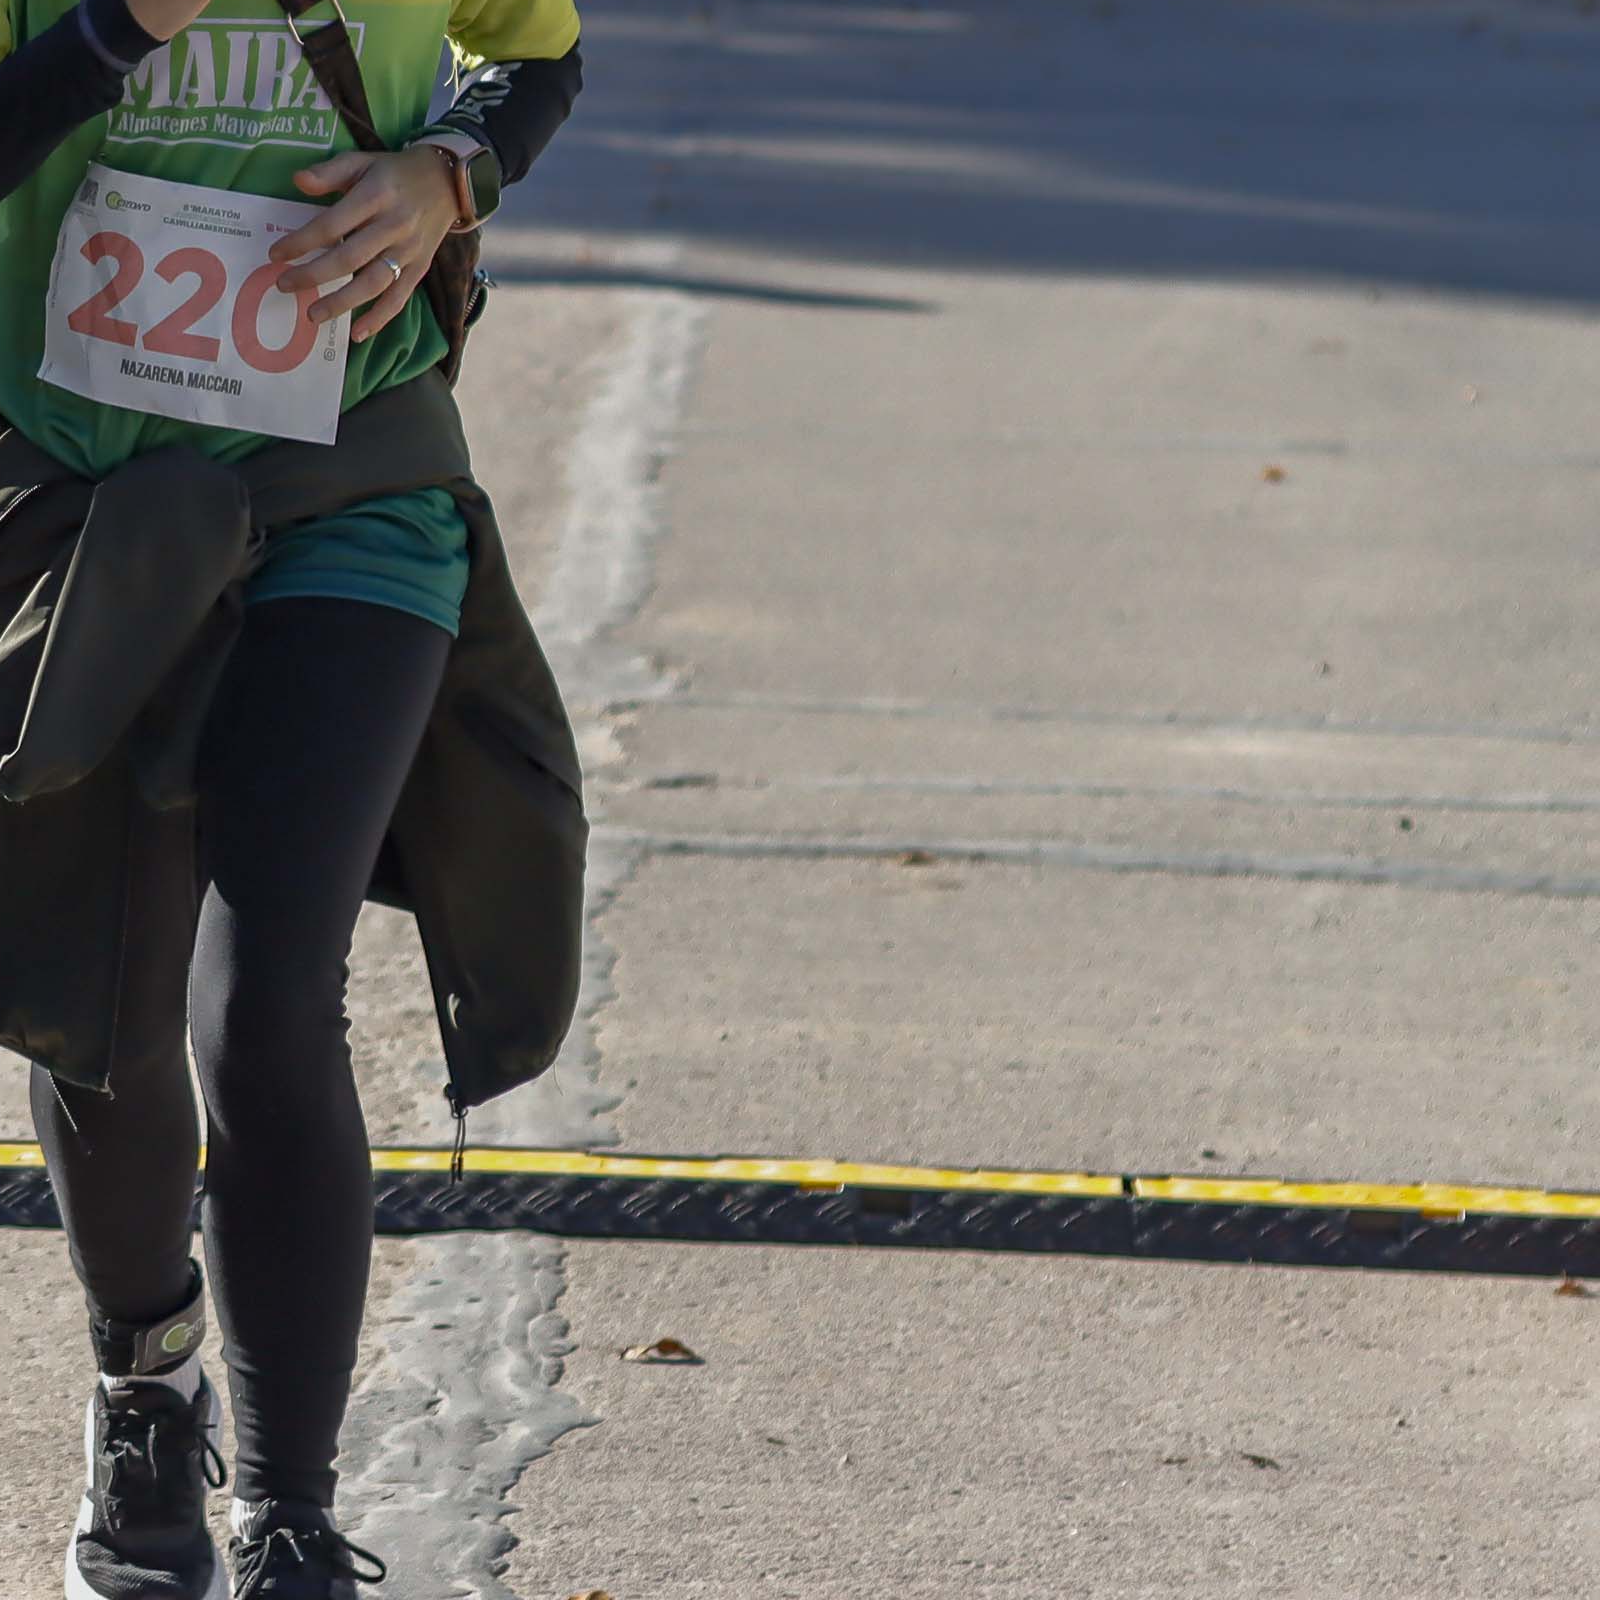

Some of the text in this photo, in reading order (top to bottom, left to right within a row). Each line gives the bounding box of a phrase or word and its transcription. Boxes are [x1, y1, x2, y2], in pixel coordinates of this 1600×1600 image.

[118, 112, 207, 134] Almacenes
[299, 114, 329, 137] S.A.
[67, 231, 320, 374] 220
[120, 358, 243, 396] NAZARENA MACCARI
